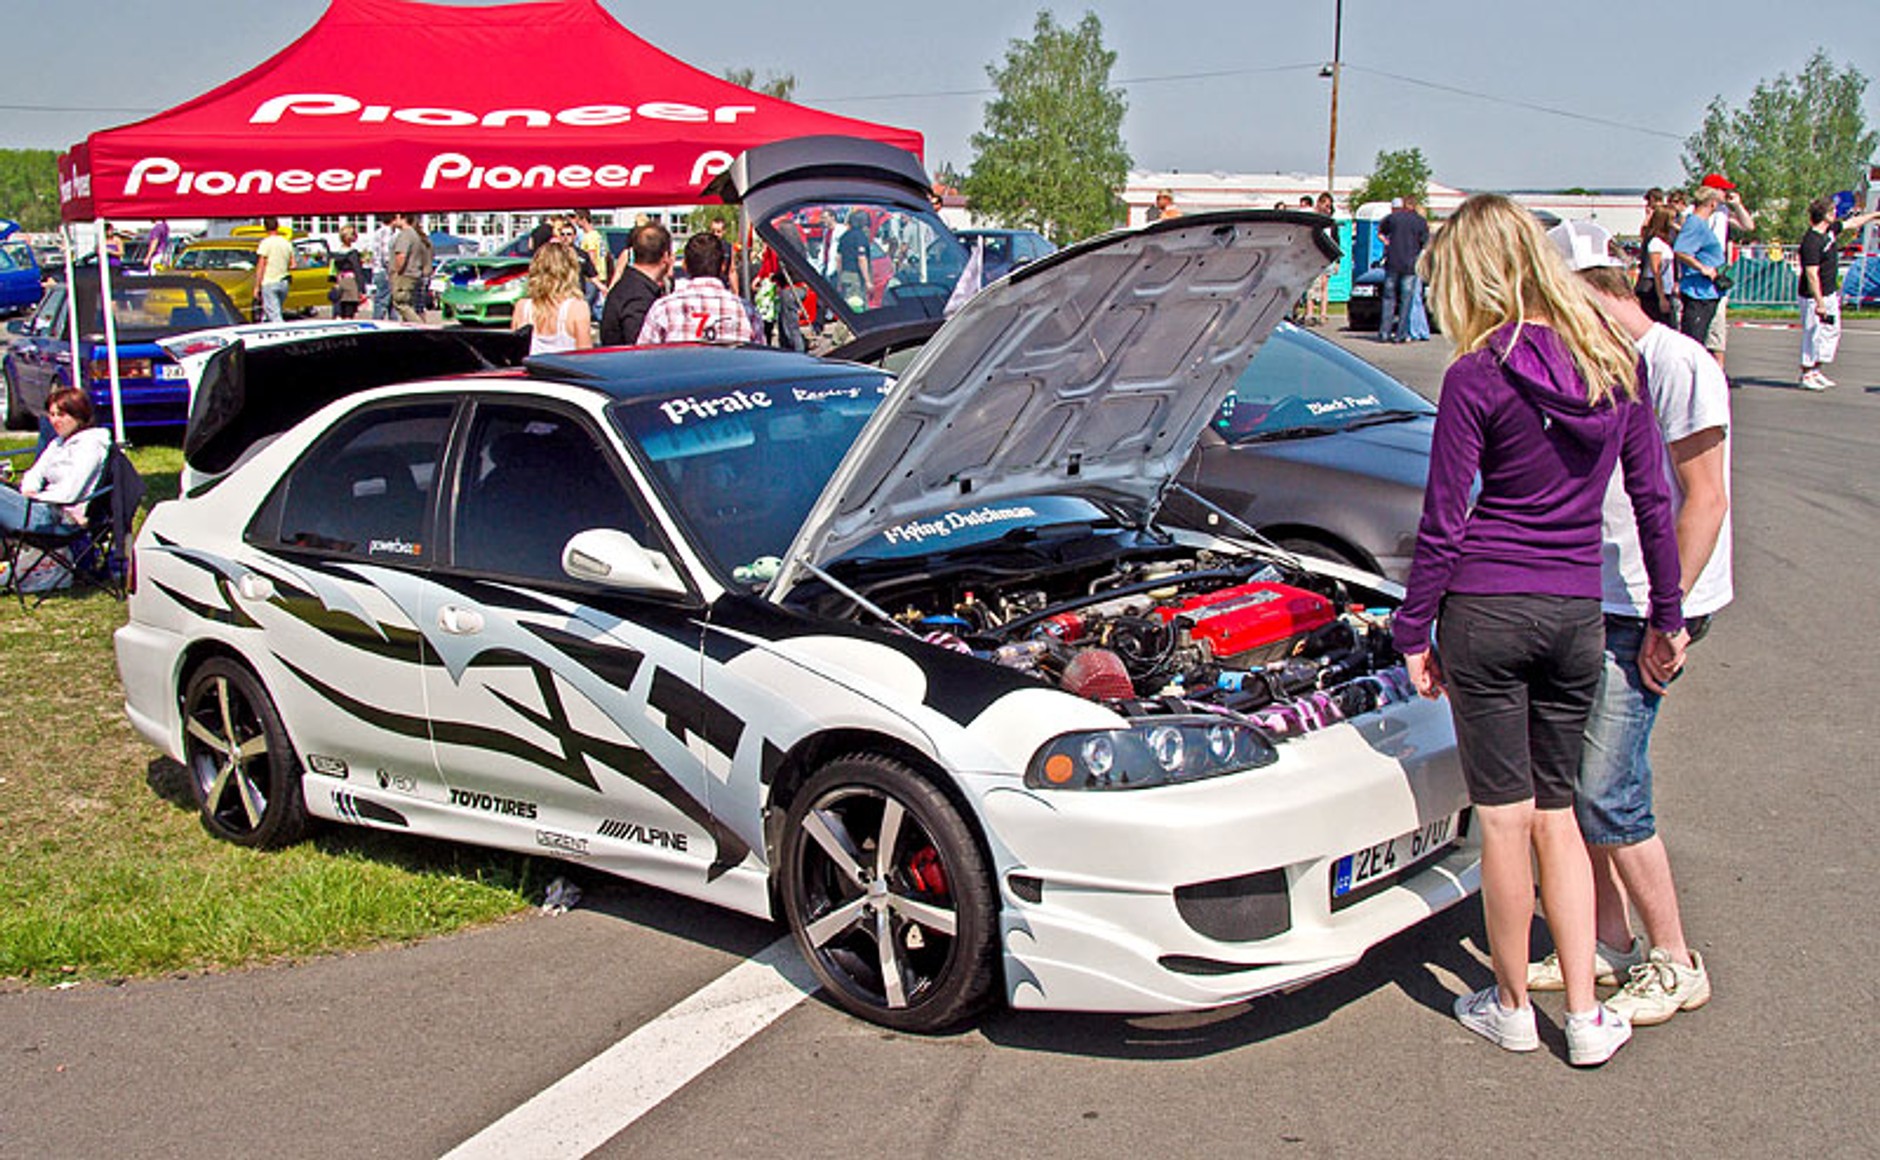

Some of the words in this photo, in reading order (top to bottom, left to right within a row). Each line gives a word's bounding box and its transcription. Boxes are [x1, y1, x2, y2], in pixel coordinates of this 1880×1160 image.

[249, 93, 756, 127] Pioneer
[123, 157, 382, 196] Pioneer
[420, 152, 655, 190] Pioneer
[659, 389, 773, 425] Pirate
[628, 824, 688, 852] ALPINE
[1355, 838, 1396, 882] 2E4
